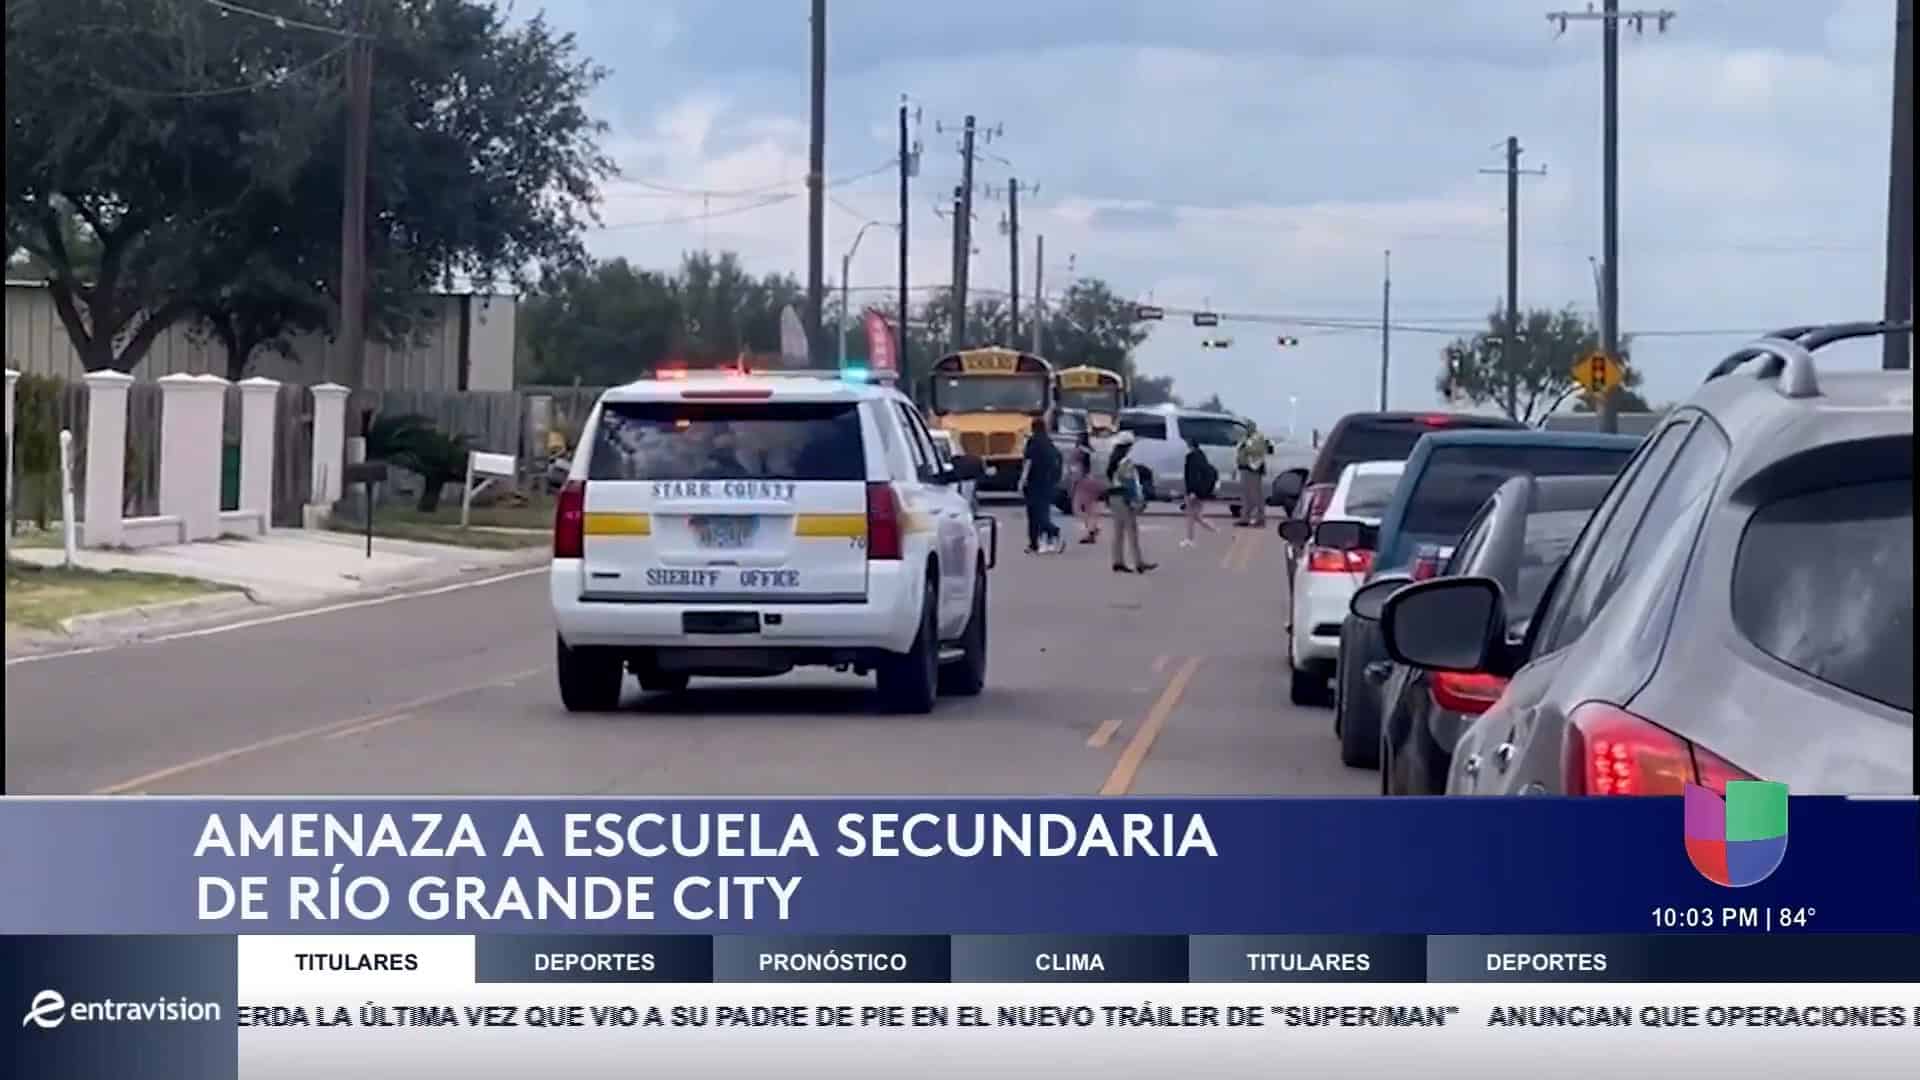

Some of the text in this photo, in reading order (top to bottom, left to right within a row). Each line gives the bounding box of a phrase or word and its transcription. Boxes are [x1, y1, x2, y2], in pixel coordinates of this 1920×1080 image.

[723, 482, 797, 500] COUNTY
[645, 568, 801, 588] SHERIFF OFFICE
